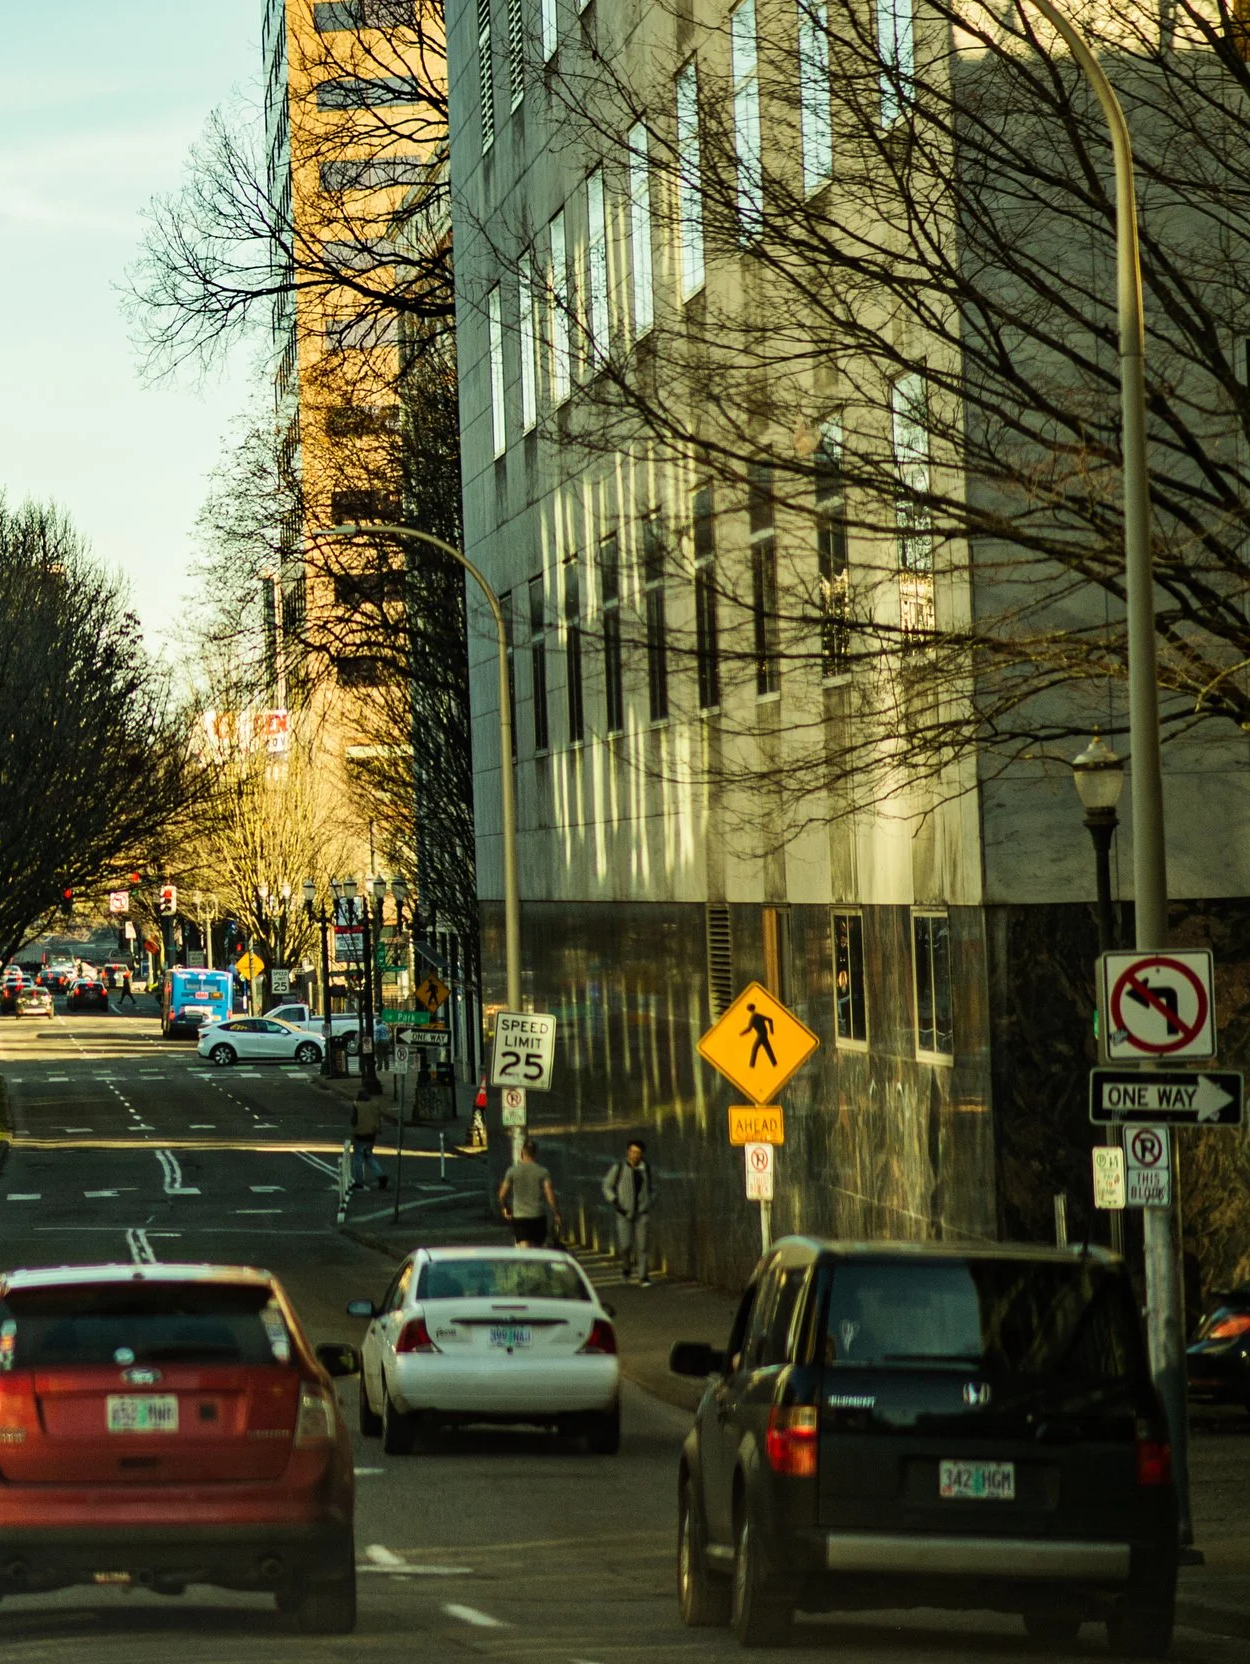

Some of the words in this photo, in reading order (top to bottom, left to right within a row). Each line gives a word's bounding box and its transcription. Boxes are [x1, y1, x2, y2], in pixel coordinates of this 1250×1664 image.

[273, 982, 287, 991] 25
[397, 1013, 416, 1022] Park
[501, 1019, 549, 1034] SPEED
[411, 1033, 427, 1041] ONE
[430, 1034, 446, 1042] WAY
[504, 1035, 543, 1049] LIMIT
[499, 1051, 544, 1081] 25
[1108, 1086, 1148, 1107] ONE
[1157, 1087, 1197, 1108] WAY
[736, 1118, 778, 1133] AHEAD
[945, 1468, 971, 1488] 342
